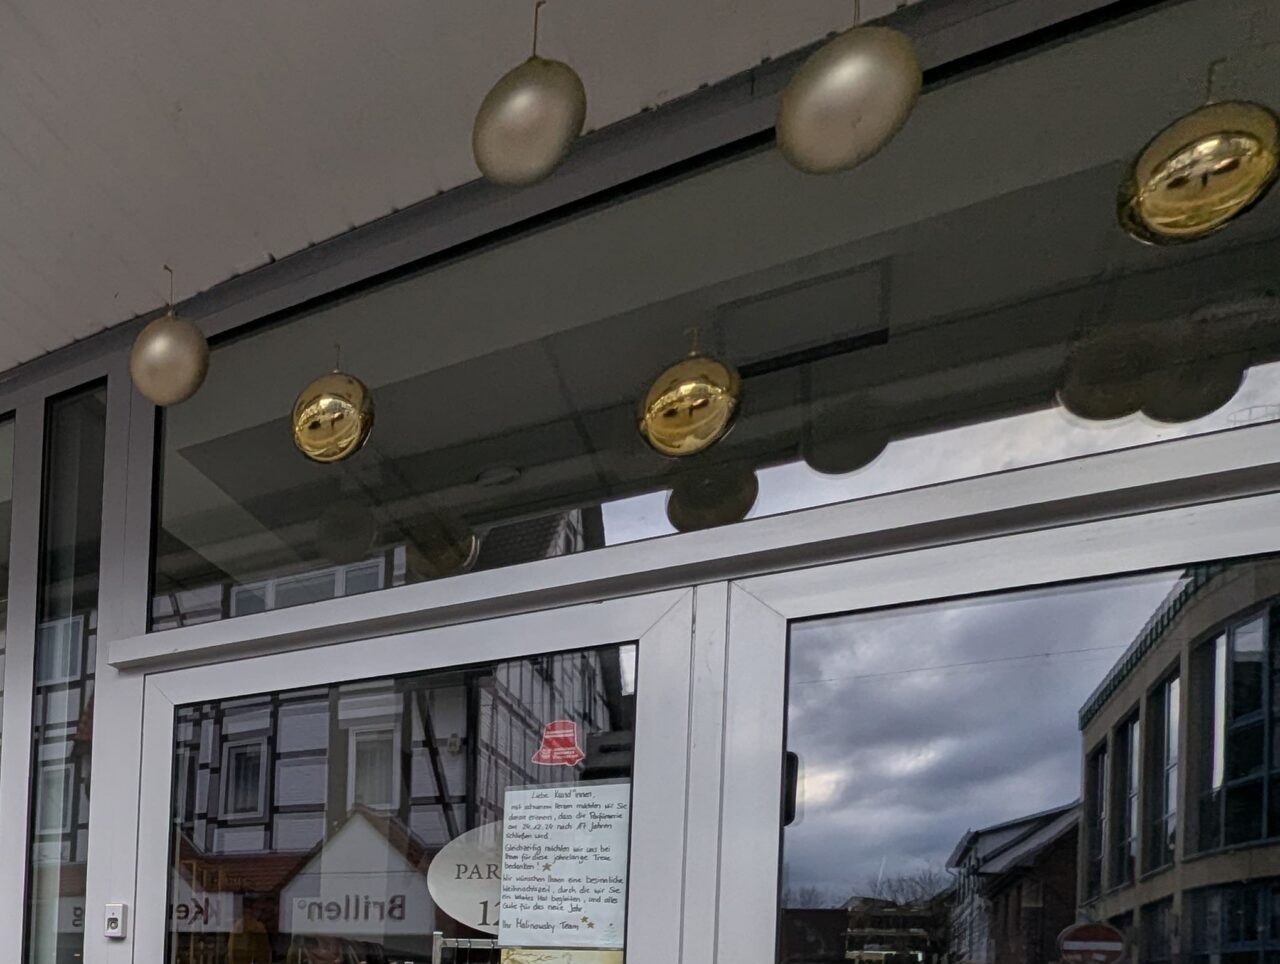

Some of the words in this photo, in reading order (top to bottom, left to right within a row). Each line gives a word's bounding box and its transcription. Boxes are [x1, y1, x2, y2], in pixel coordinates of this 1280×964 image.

[617, 802, 628, 810] Sie
[558, 812, 572, 820] dass
[556, 822, 572, 830] nach
[589, 821, 613, 832] Jahren
[600, 844, 611, 853] bei
[521, 853, 531, 862] für
[532, 852, 548, 860] diese
[455, 863, 501, 880] PAR
[558, 885, 576, 893] durch
[580, 885, 590, 893] die
[609, 886, 621, 894] Sie
[604, 896, 618, 904] alles
[519, 903, 530, 912] für
[502, 920, 512, 929] Ihr
[559, 921, 579, 931] Team
